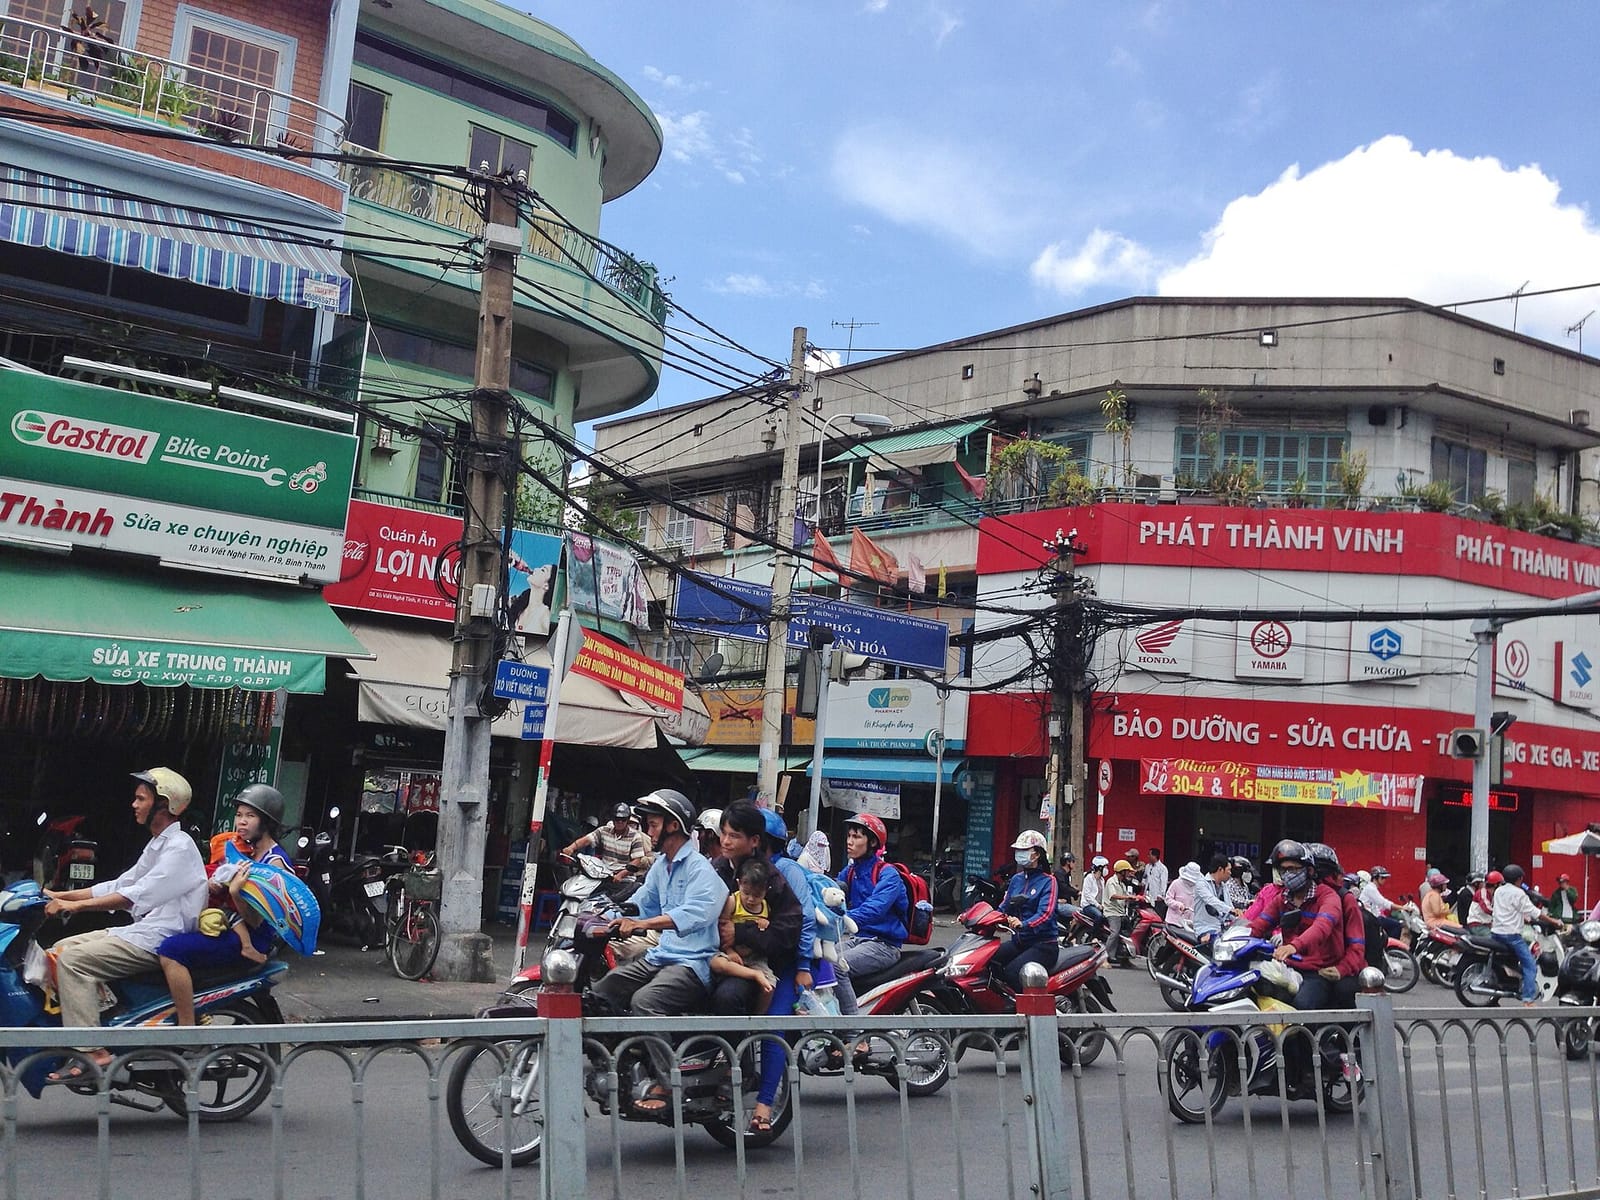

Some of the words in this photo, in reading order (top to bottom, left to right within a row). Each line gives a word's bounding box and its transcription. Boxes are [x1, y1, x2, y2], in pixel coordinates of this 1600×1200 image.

[47, 419, 148, 459] Castrol
[165, 435, 211, 459] Bike
[214, 445, 270, 470] Point
[0, 492, 115, 537] Thành
[123, 512, 162, 532] Sửa
[166, 523, 189, 536] xe
[194, 525, 263, 548] chuyên
[266, 537, 328, 560] nghiệp
[380, 526, 416, 545] Quán
[418, 530, 437, 547] Ăn
[1140, 516, 1215, 546] PHÁT
[1225, 519, 1324, 550] THÀNH
[1333, 526, 1404, 553] VINH
[188, 543, 197, 552] 10
[1455, 534, 1506, 567] PHÁT
[1510, 546, 1569, 581] THÀNH
[375, 547, 415, 583] LỢI
[92, 644, 130, 666] SỬA
[135, 650, 160, 668] XE
[166, 653, 227, 672] TRUNG
[233, 655, 291, 675] THÀNH
[859, 640, 888, 656] HÓA
[1138, 656, 1178, 665] HONDA
[1251, 660, 1287, 671] YAMAHA
[1364, 665, 1407, 677] PIAGGIO
[112, 667, 133, 679] SỐ
[136, 671, 151, 680] 10
[161, 672, 196, 682] XVNT
[206, 675, 232, 684] F.19
[242, 677, 272, 686] Q.BT
[510, 667, 538, 680] ĐƯỜNG
[505, 678, 518, 693] VIẾT
[518, 682, 533, 698] NGHỆ
[1569, 690, 1593, 700] SUZUKI
[1113, 708, 1163, 739] BẢO
[1172, 714, 1260, 745] DƯỠNG
[1287, 717, 1336, 748] SỬA
[1342, 723, 1412, 752] CHỮA
[1174, 759, 1217, 774] Nhân
[1220, 761, 1250, 777] Dịp
[1529, 743, 1549, 766] XE
[1551, 747, 1573, 768] GA
[1581, 750, 1600, 771] XE
[1143, 758, 1168, 793] Lễ
[1172, 774, 1204, 794] 30-4
[1211, 777, 1223, 796] &
[1230, 778, 1254, 799] 1-5
[1381, 774, 1396, 807] 01
